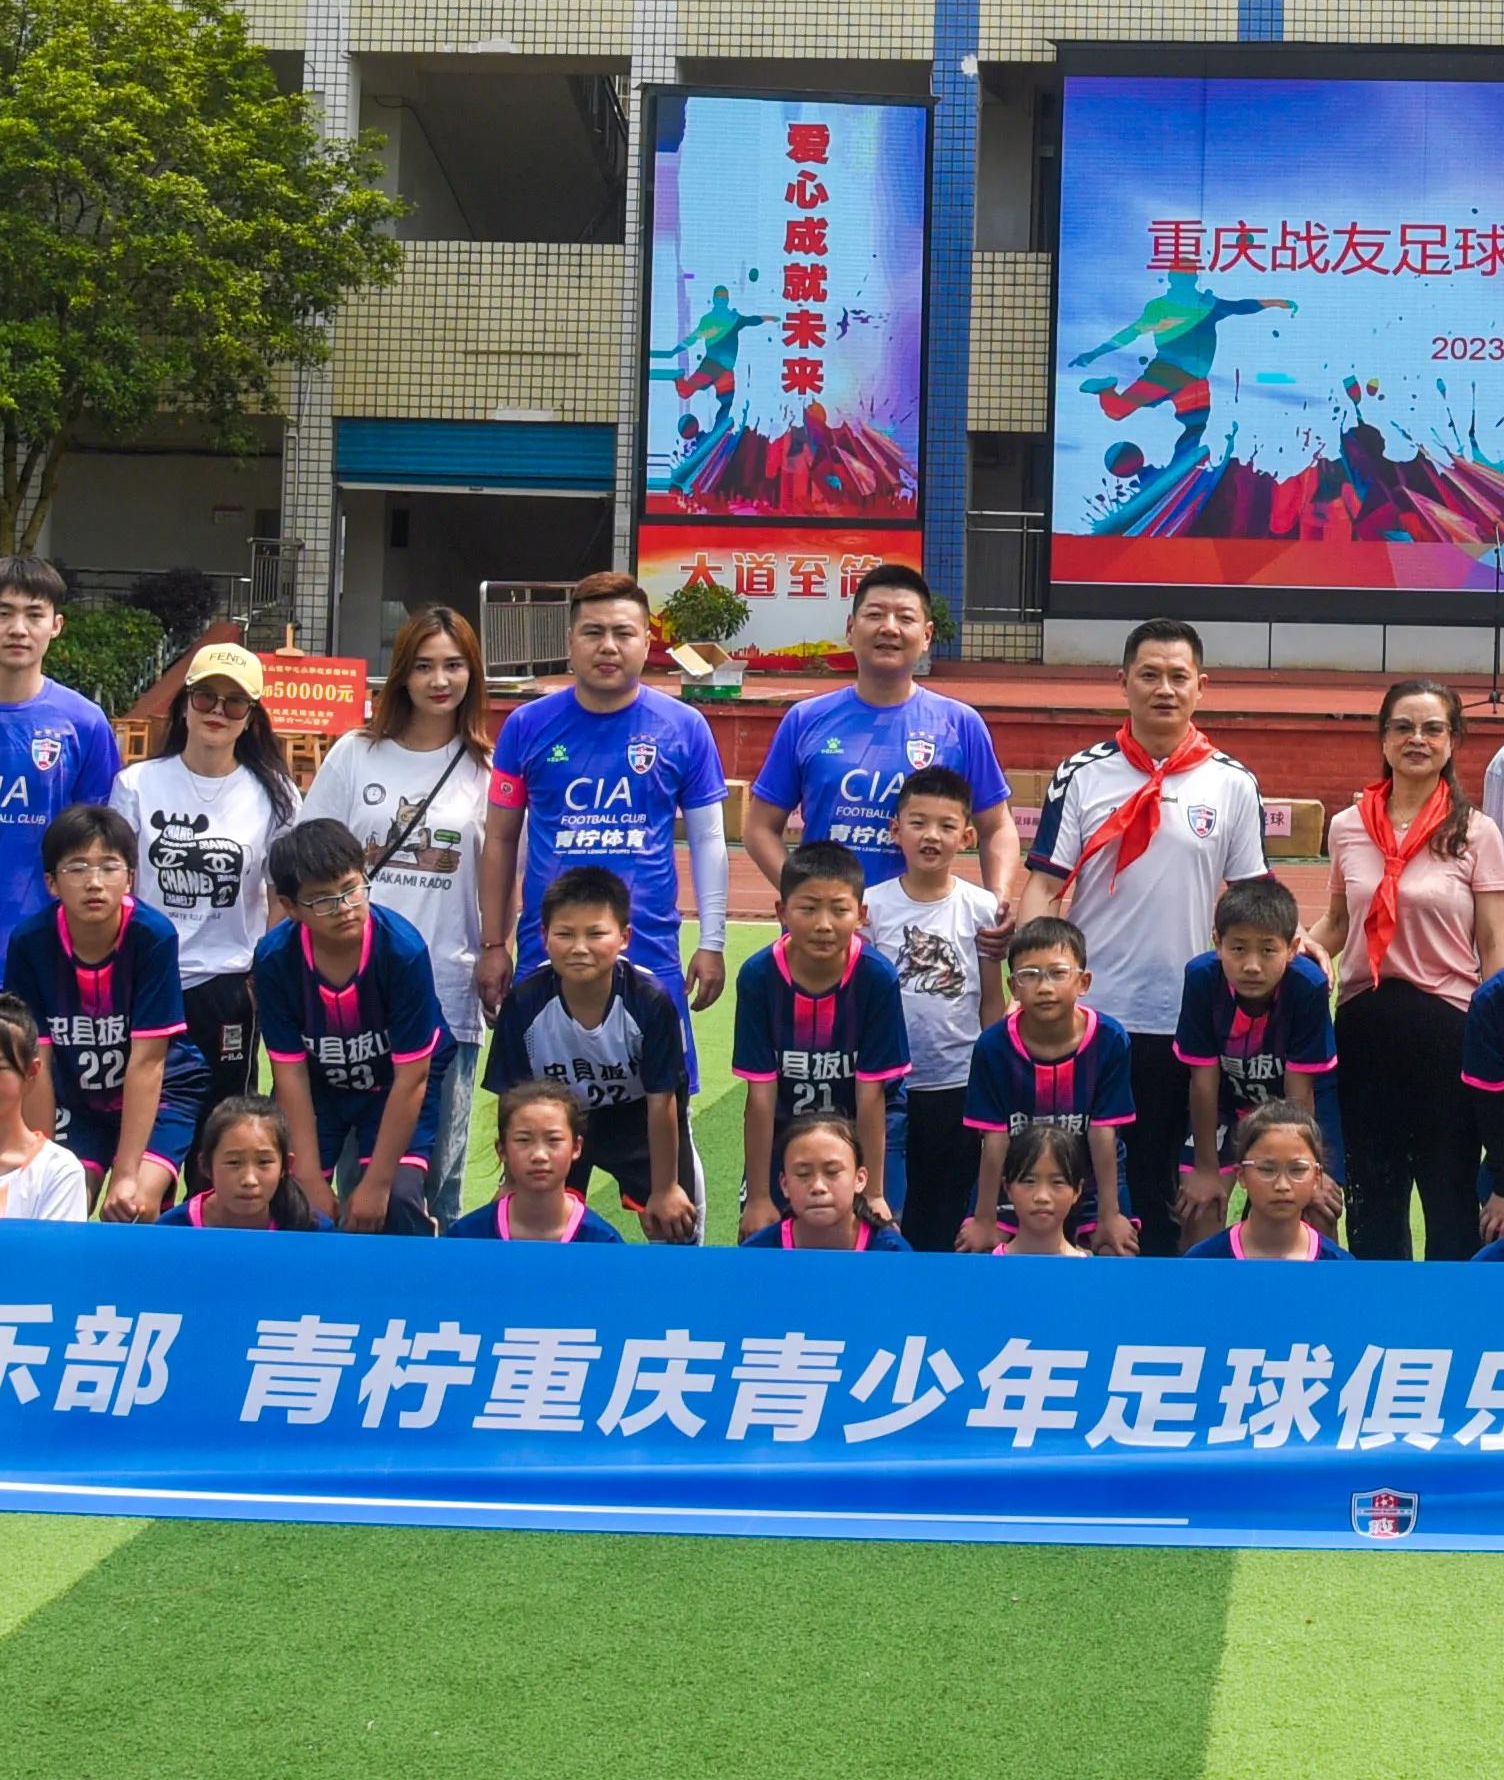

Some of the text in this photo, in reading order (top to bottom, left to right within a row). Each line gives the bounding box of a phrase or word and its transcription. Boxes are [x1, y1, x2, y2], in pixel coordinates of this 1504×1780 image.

[781, 122, 830, 396] 爱心成就未来
[564, 776, 632, 811] CIA
[840, 768, 906, 803] CIA
[17, 813, 46, 825] CLUB
[561, 813, 647, 825] FOOTBALL CLUB
[555, 829, 646, 849] 青柠体育
[77, 1049, 125, 1090] 22
[325, 1064, 375, 1090] 23
[792, 1083, 836, 1115] 21
